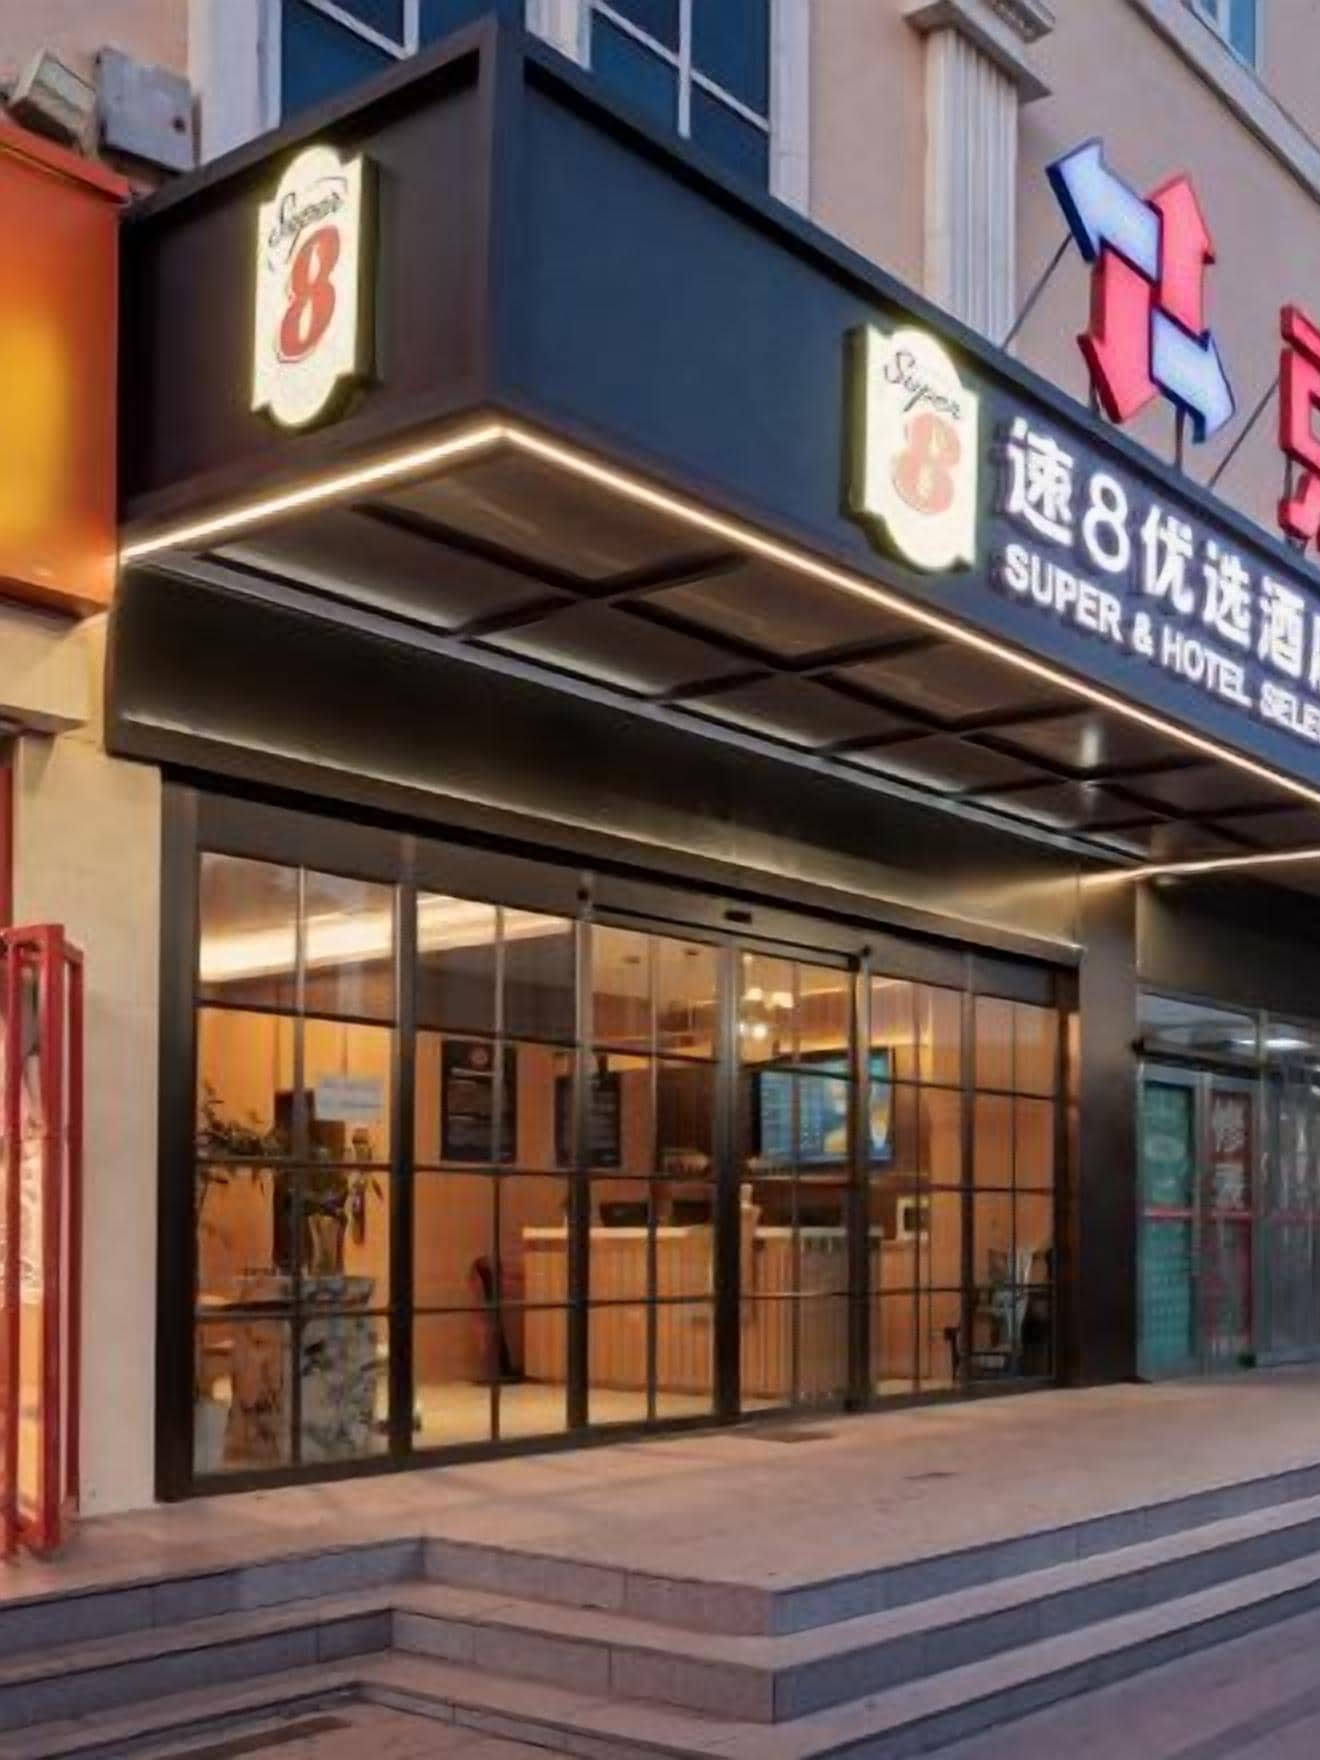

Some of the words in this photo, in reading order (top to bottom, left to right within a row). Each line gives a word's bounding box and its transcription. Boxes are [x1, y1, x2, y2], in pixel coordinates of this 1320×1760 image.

[275, 224, 341, 364] 8
[883, 350, 961, 421] Super
[891, 411, 962, 515] 8
[1004, 544, 1123, 643] SUPER
[1131, 611, 1154, 656] &
[1161, 624, 1252, 708] HOTEL
